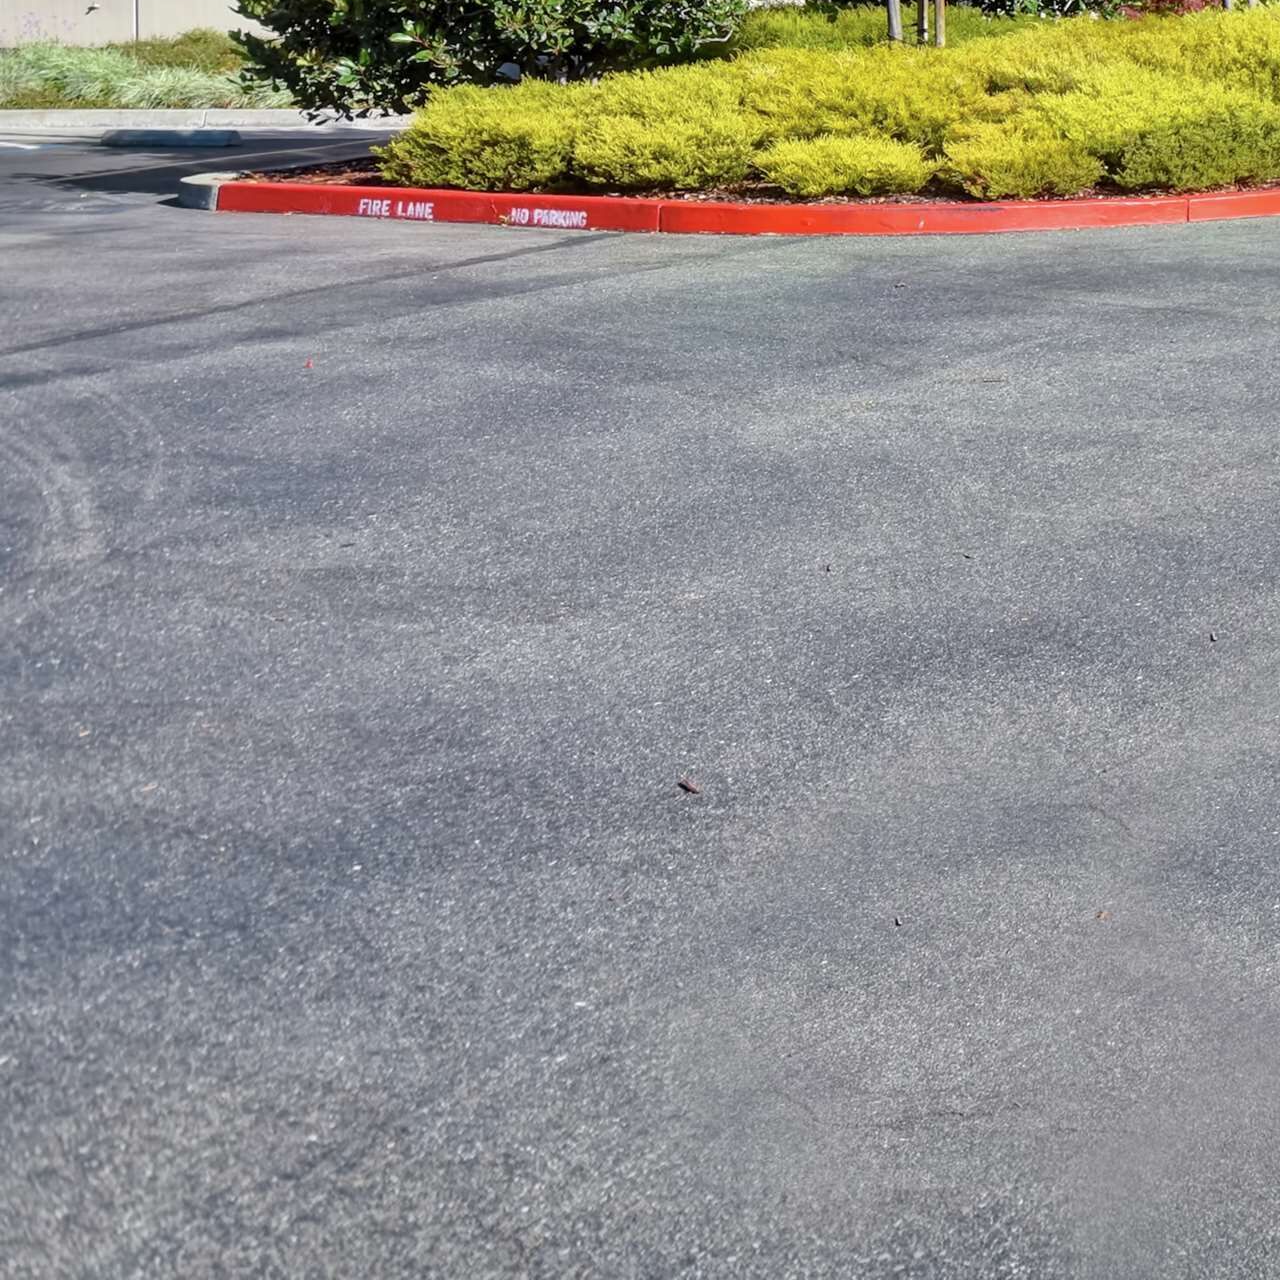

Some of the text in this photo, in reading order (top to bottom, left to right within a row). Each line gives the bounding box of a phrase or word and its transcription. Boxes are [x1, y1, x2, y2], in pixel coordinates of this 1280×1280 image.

[359, 198, 434, 219] FIRE LANE
[511, 207, 587, 227] NO PARKING
